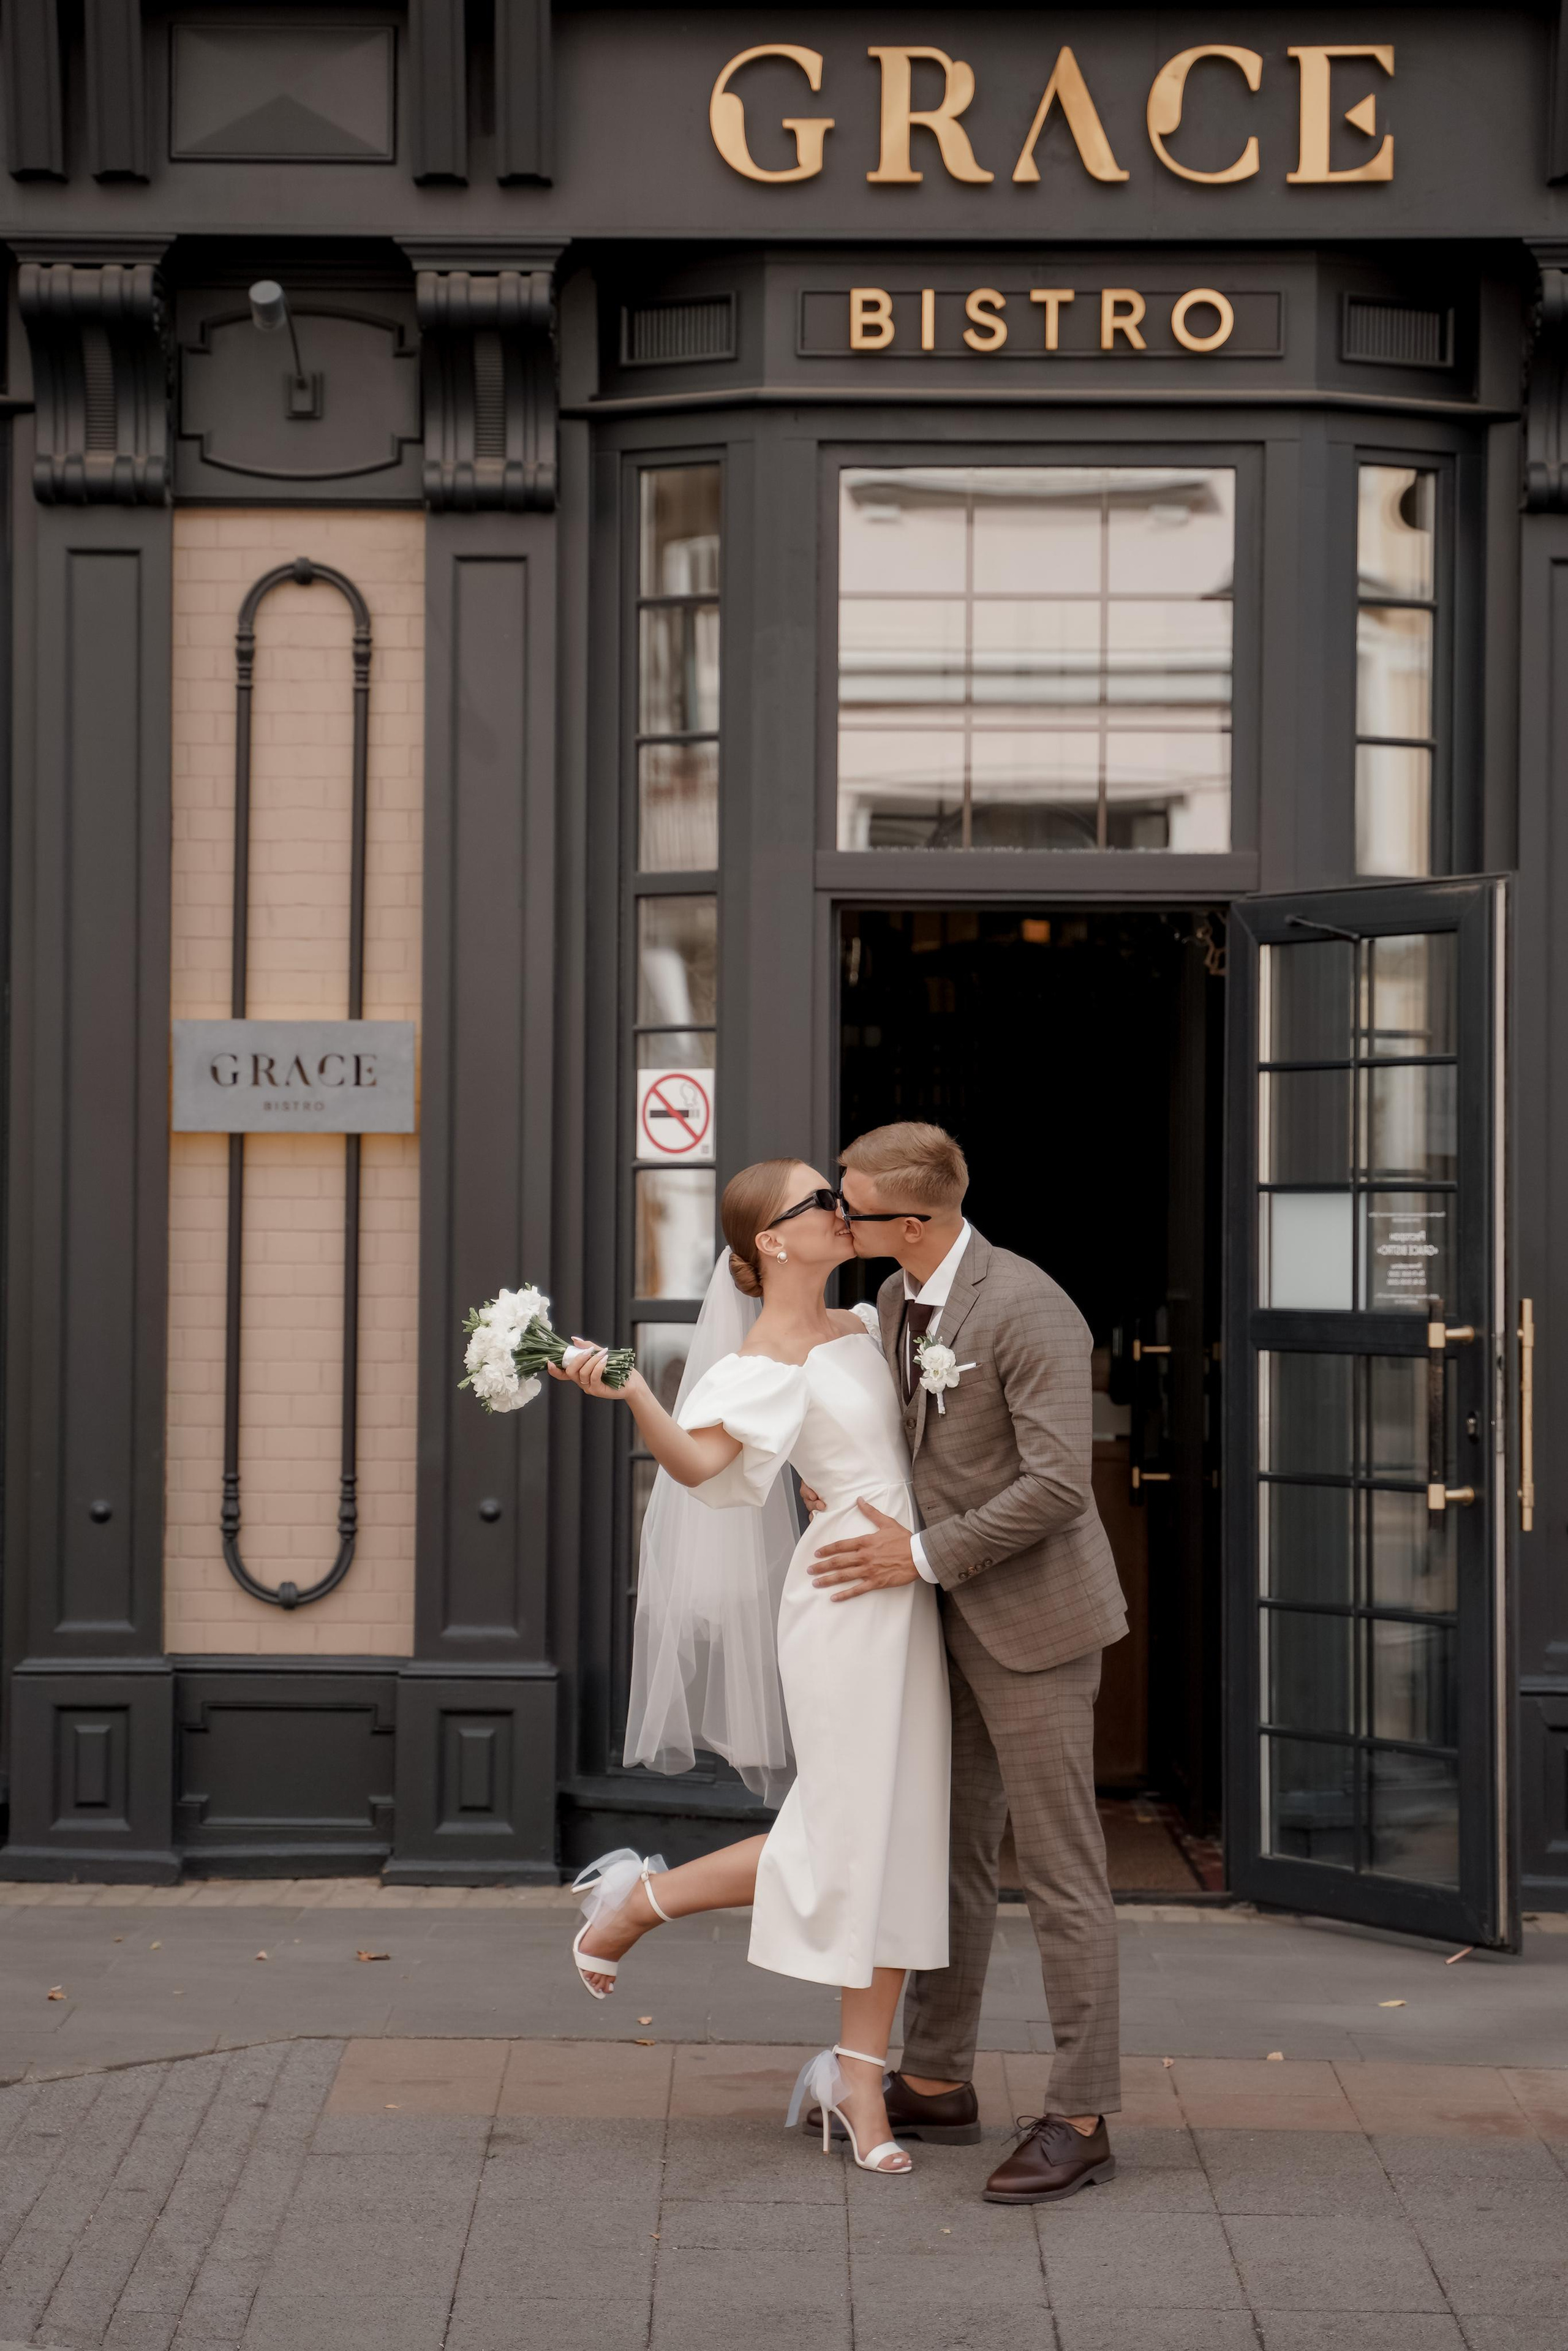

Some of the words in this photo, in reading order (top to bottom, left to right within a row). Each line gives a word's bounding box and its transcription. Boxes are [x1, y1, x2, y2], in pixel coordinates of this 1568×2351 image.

[709, 43, 1395, 183] GRACE
[850, 287, 1235, 352] BISTRO
[210, 1052, 377, 1087] GRACE
[263, 1101, 326, 1112] BISTRO
